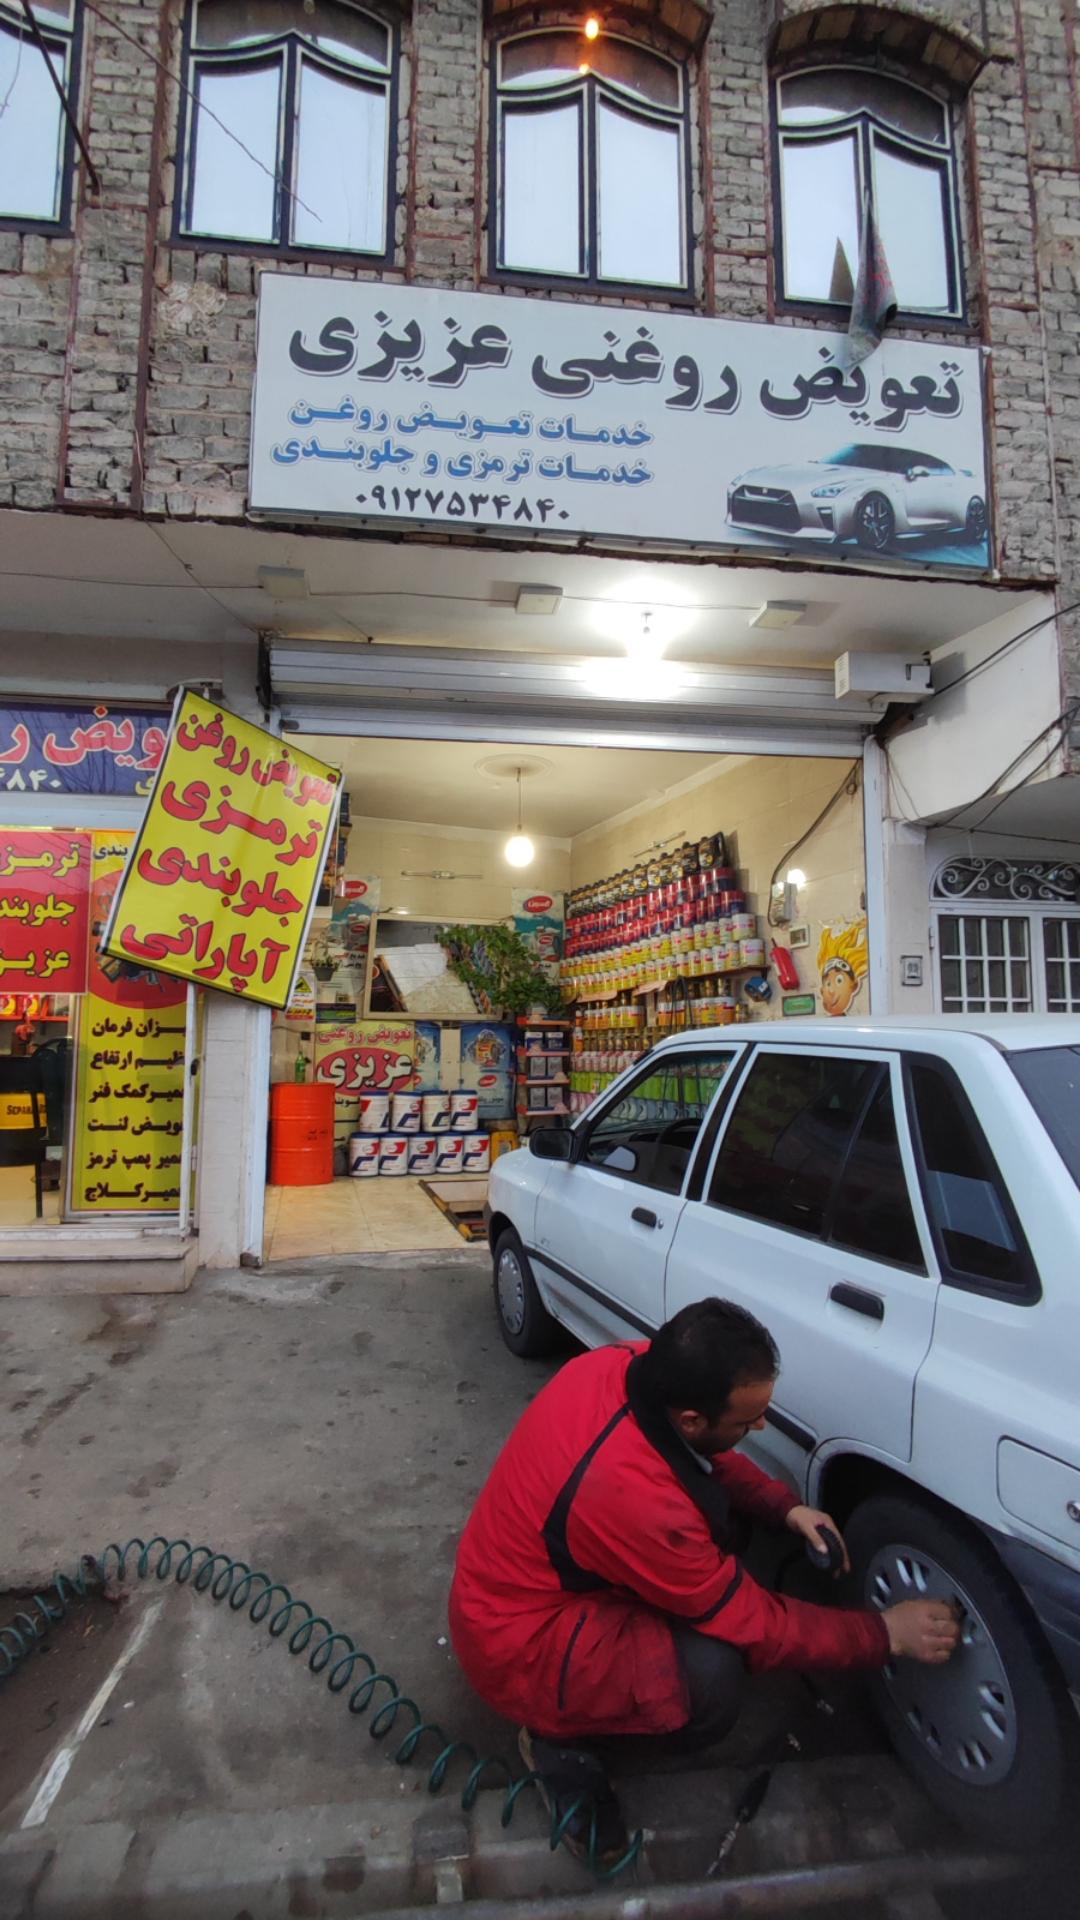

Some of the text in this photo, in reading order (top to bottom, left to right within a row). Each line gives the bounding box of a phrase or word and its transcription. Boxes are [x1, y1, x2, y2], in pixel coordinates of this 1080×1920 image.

[288, 310, 961, 430] تعویض روغنی عزیزی
[291, 397, 651, 446] خدمات تعویض روغن
[272, 438, 651, 485] خدمات ترمزی و جلوبندی
[355, 484, 569, 523] ۰۹۱۲۷۵۳۴۸۴۰
[43, 706, 165, 770] ویض
[177, 713, 338, 806] تعویض روغن
[161, 781, 322, 866] ترمزی
[0, 842, 80, 877] ترمز
[93, 844, 128, 860] بندی
[138, 847, 303, 928] جلوبندی
[0, 893, 75, 927] جلوبند
[120, 913, 290, 993] آپاراتی
[92, 1017, 133, 1037] فرمان
[90, 1050, 185, 1070] ظیم ارتفاع
[315, 1053, 413, 1089] عزیزی
[89, 1082, 112, 1103] فنر
[114, 1083, 149, 1099] کمک
[87, 1116, 129, 1131] لنت
[86, 1150, 118, 1169] ترمز
[121, 1153, 152, 1170] پمپ
[84, 1183, 144, 1202] کلاج
